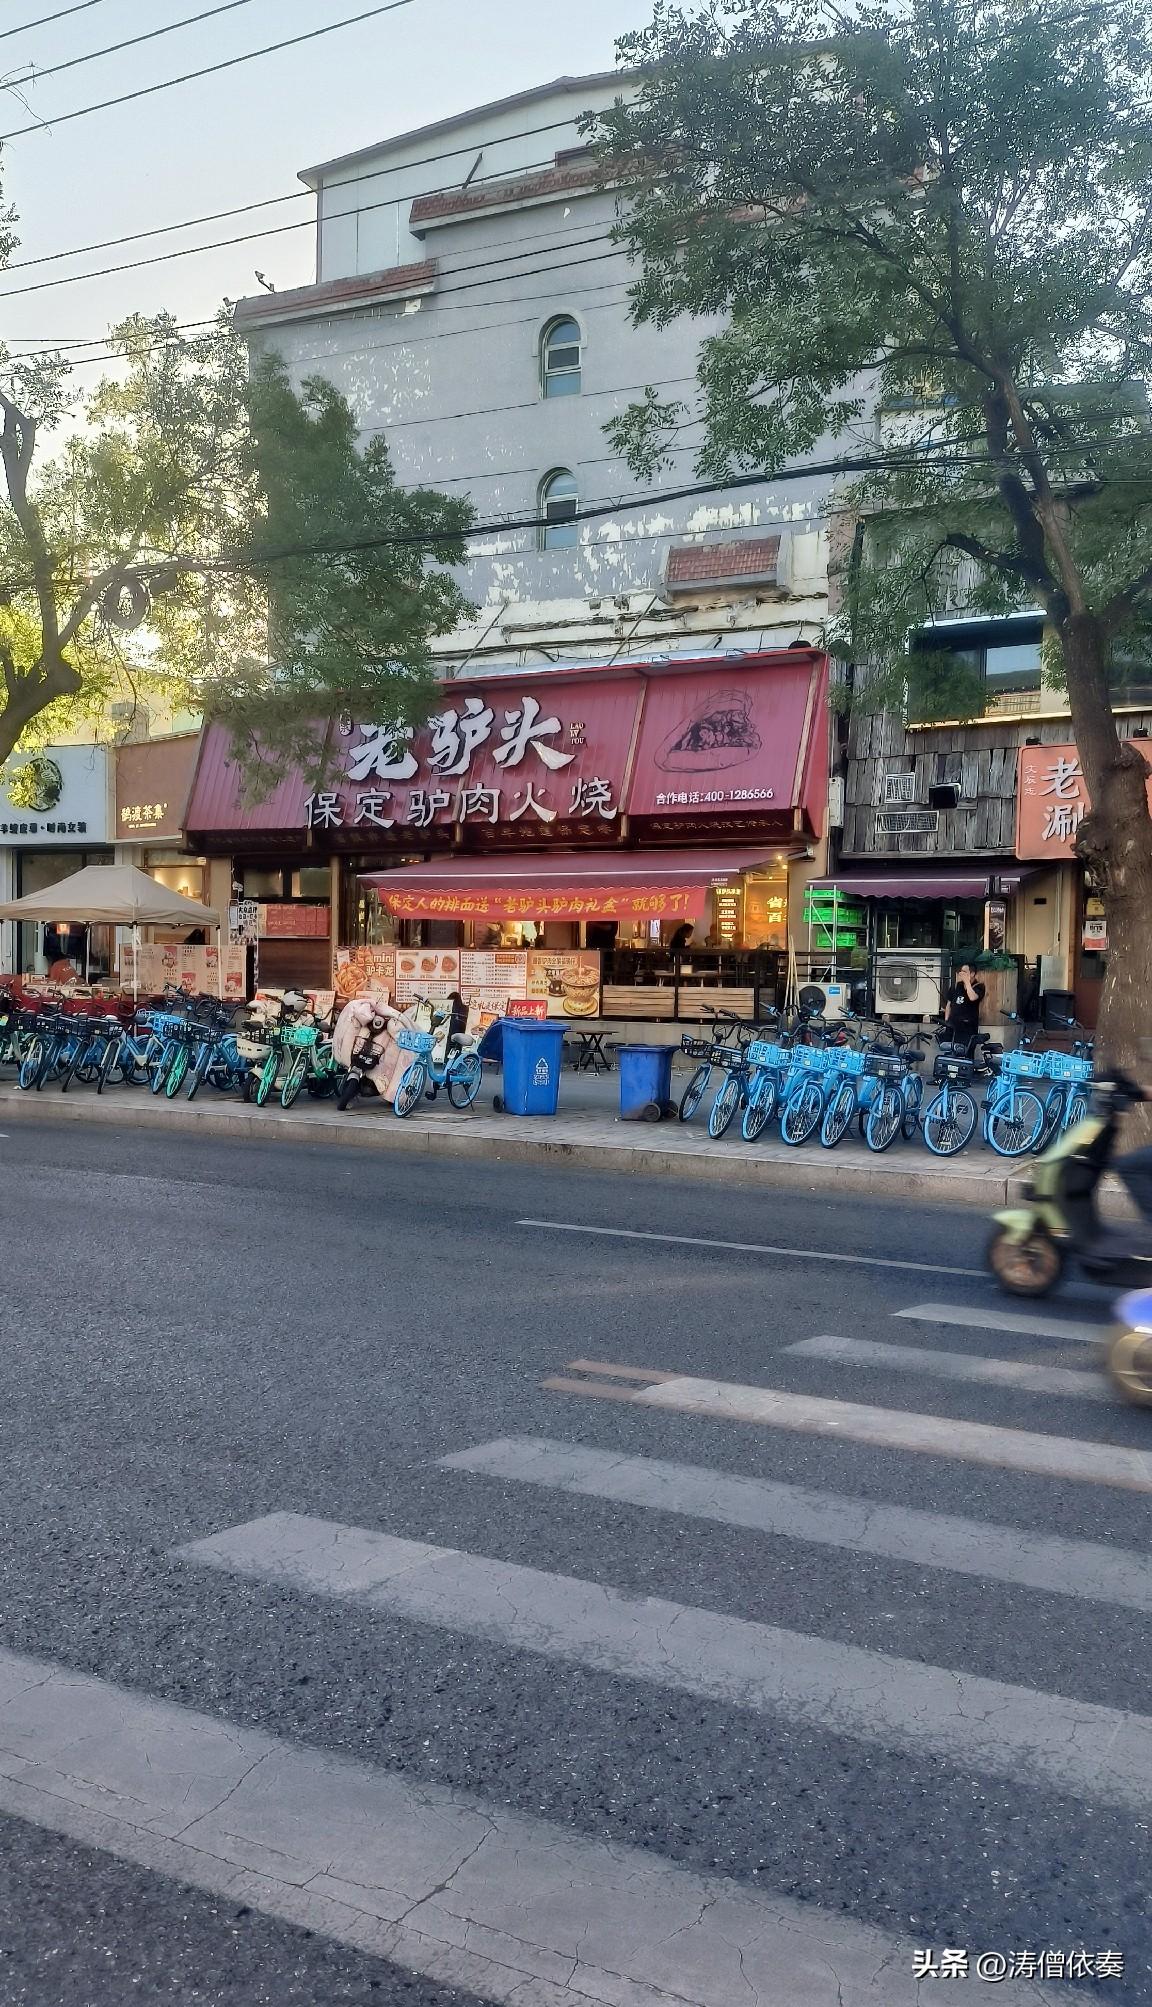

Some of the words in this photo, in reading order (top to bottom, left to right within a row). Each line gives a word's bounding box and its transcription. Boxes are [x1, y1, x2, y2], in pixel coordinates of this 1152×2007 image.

[348, 697, 576, 781] 老驴头
[656, 788, 774, 805] 合作电话:400-1286566
[1038, 756, 1083, 799] 老
[305, 777, 617, 829] 保定驴肉火烧
[1041, 801, 1085, 843] 涮
[366, 965, 394, 977] 驴卡龙
[373, 952, 394, 963] mini
